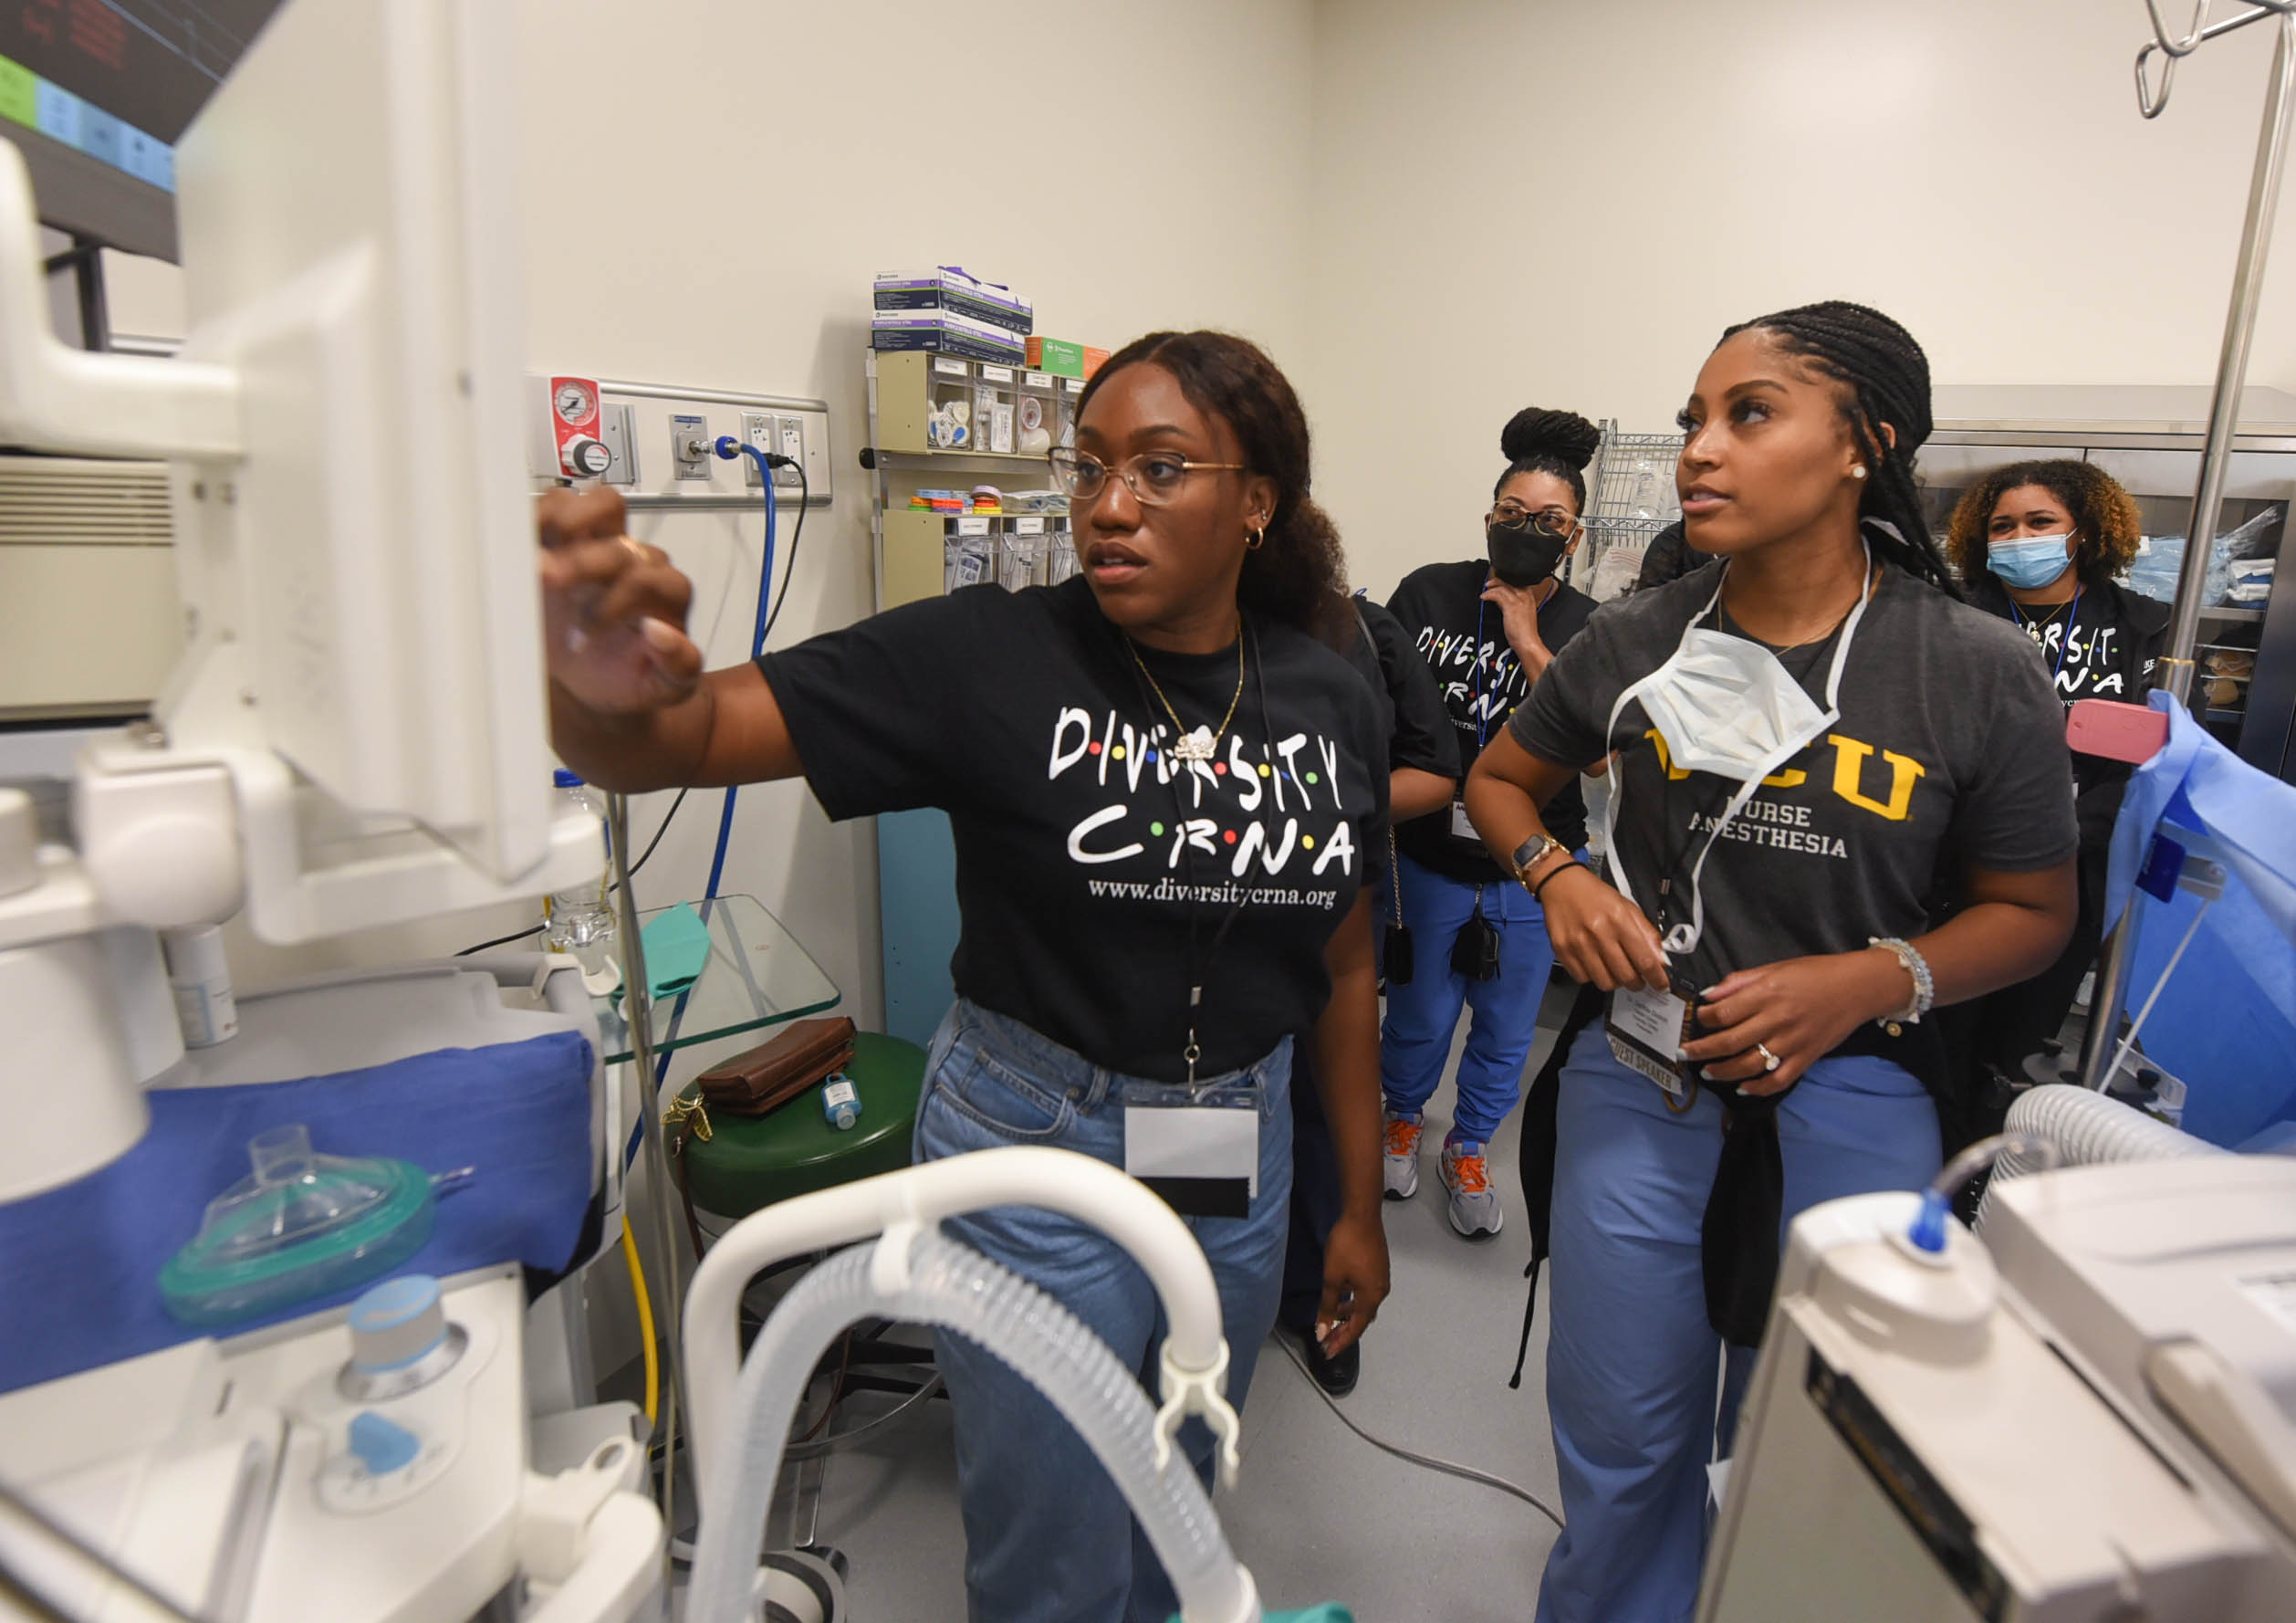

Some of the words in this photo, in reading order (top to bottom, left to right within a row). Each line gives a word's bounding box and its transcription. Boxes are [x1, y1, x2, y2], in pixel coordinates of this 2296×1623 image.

[1067, 803, 1355, 877] CRNA
[1688, 811, 1848, 859] ANESTHESIA
[1089, 877, 1337, 910] www.diversitycrna.org
[1636, 1055, 1673, 1090] SPEAKER
